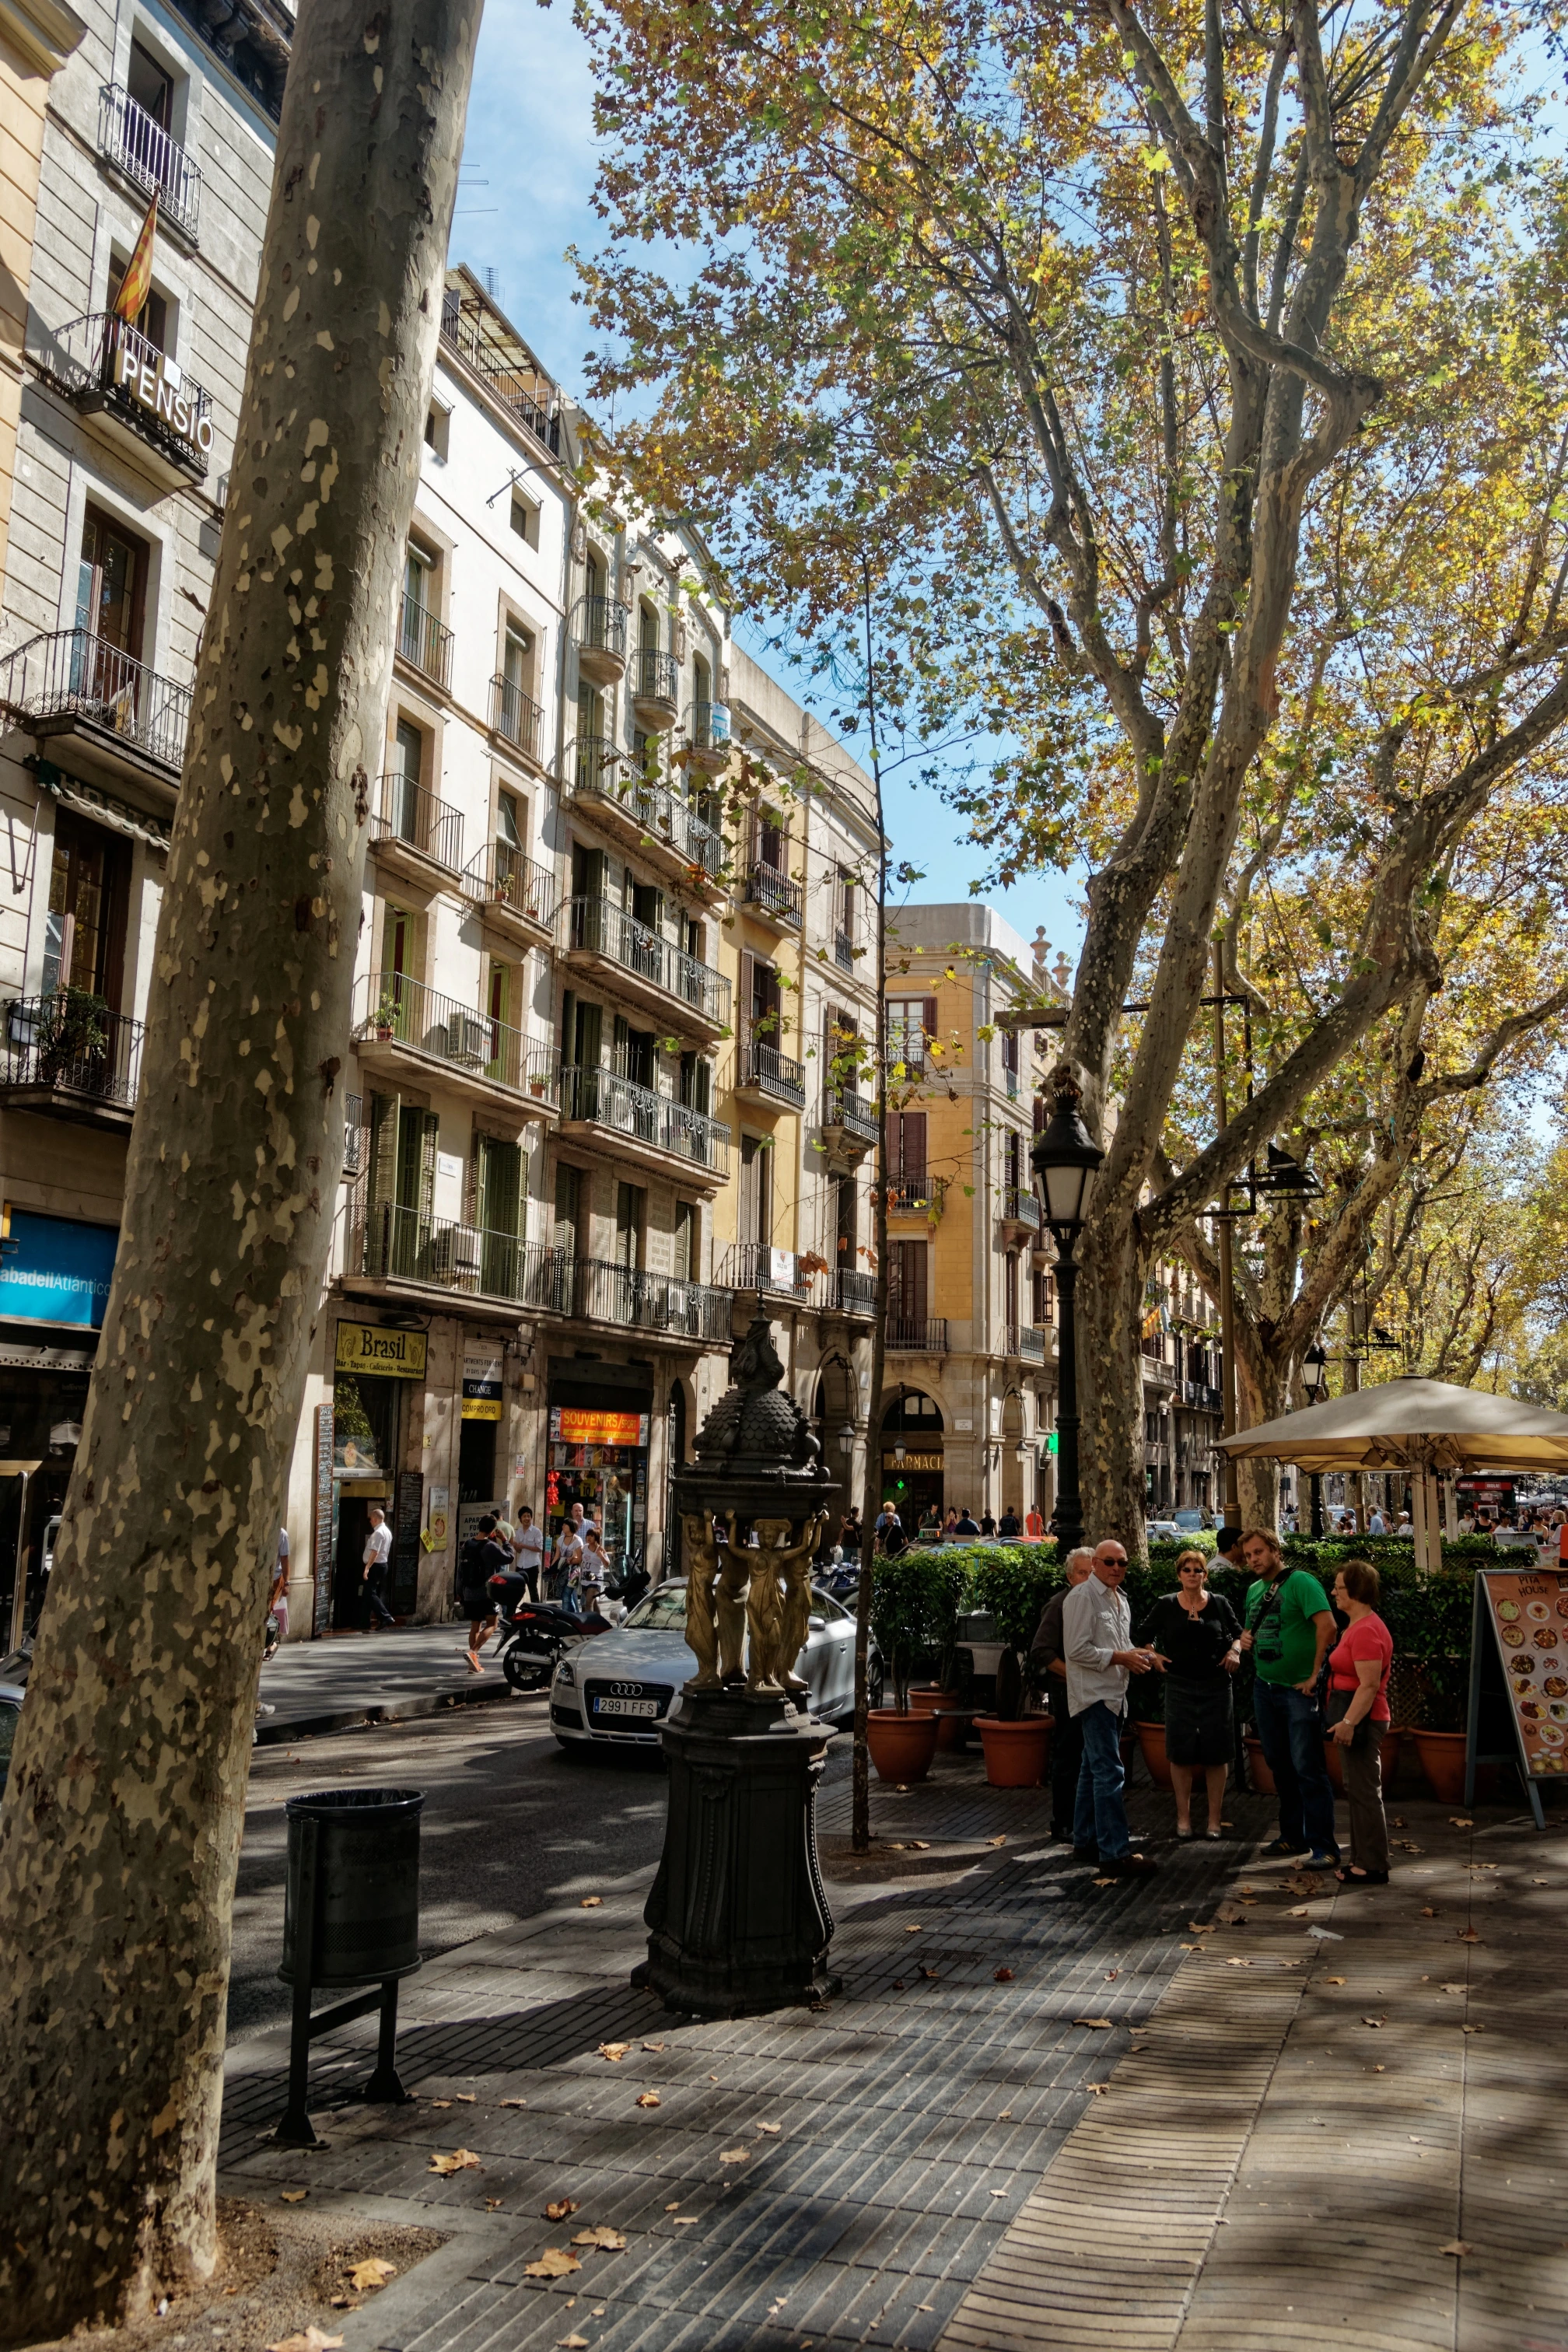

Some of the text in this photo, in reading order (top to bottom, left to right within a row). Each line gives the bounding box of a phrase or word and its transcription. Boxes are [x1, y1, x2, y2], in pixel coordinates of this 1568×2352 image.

[121, 348, 215, 453] PENSIÓ
[0, 1265, 110, 1297] abadellAtlántico
[359, 1328, 406, 1360] Brasil
[336, 1359, 346, 1367] Bar
[350, 1360, 366, 1370] Tapas
[397, 1365, 424, 1374] Restaurant
[468, 1384, 492, 1395] CHANGE
[462, 1404, 485, 1413] COMPRO
[1518, 1575, 1540, 1585] PITA
[1518, 1586, 1549, 1598] HOUSE
[600, 1699, 654, 1715] 2991 FFS
